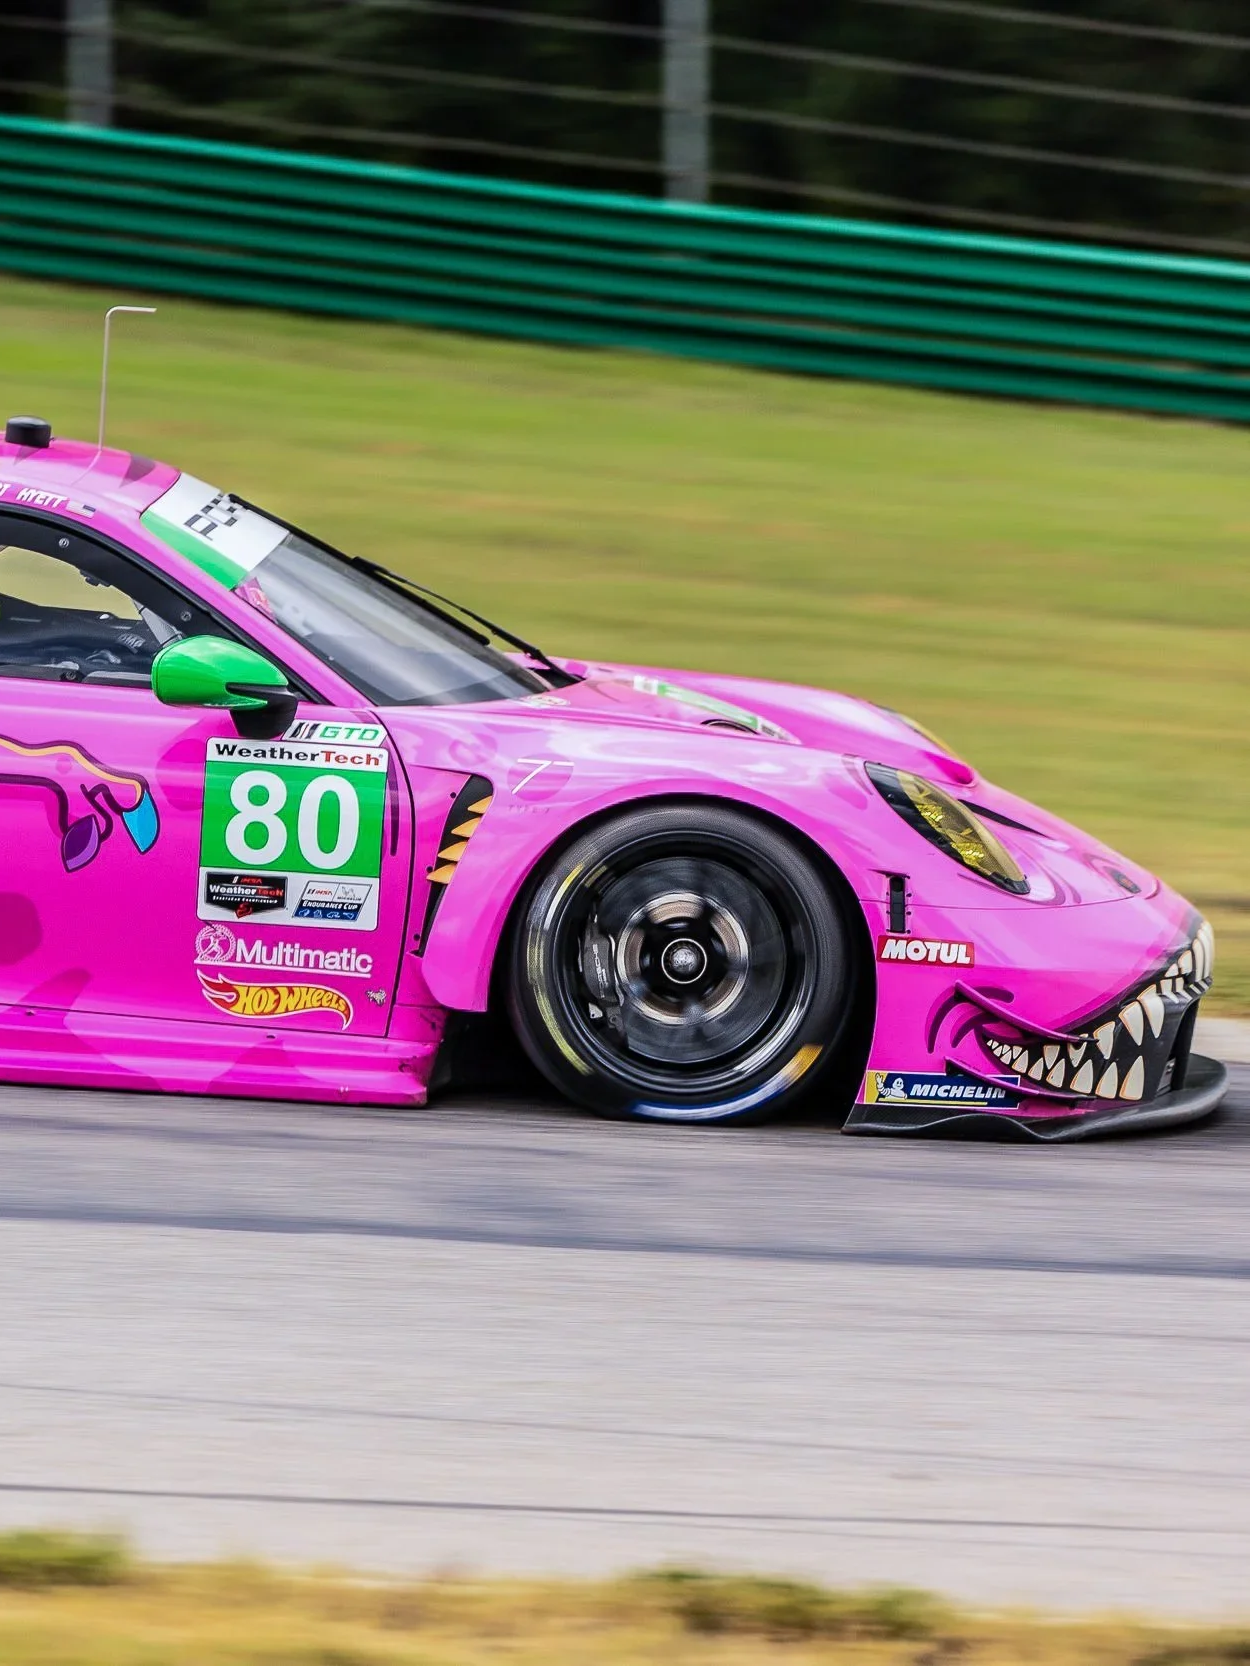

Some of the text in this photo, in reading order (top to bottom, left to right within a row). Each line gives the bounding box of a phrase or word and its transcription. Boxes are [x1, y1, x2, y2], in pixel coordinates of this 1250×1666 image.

[15, 487, 68, 508] HYETT
[319, 725, 381, 741] GTD
[225, 769, 360, 869] 80
[235, 938, 374, 974] Multimatic
[881, 938, 971, 964] MOTUL
[910, 1083, 1007, 1099] MICHELIN
